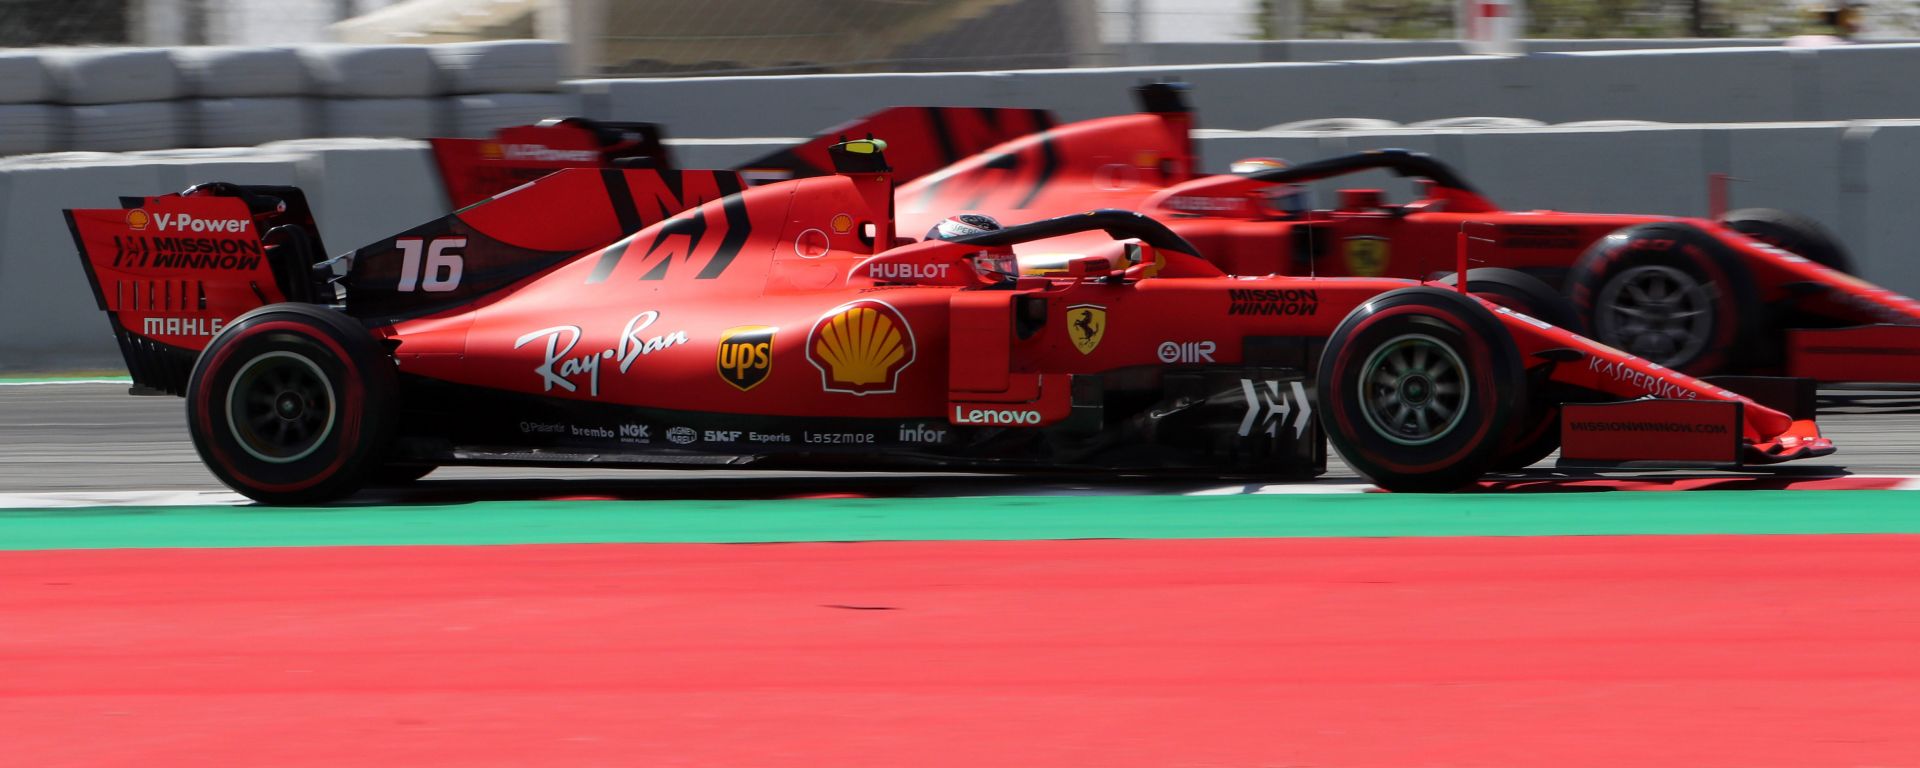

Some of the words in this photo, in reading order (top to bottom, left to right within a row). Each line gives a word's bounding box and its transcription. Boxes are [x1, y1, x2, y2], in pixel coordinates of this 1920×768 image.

[154, 213, 249, 233] V-Power
[152, 236, 261, 254] MISSION
[152, 253, 261, 270] WINNOW
[395, 238, 466, 292] 16
[869, 263, 950, 279] HUBLOT
[1228, 288, 1318, 303] MISSION
[1228, 302, 1318, 317] WINNOW
[144, 317, 222, 336] MAHLE
[721, 341, 768, 380] ups
[1589, 355, 1688, 399] KASPERSKY
[956, 405, 1041, 425] Lenovo
[571, 424, 615, 438] brembo
[620, 424, 649, 438] NGK
[899, 423, 946, 443] infor
[1570, 420, 1728, 433] MISSIONWINNOW.COM
[704, 430, 742, 442] SKF
[749, 431, 791, 444] Experis
